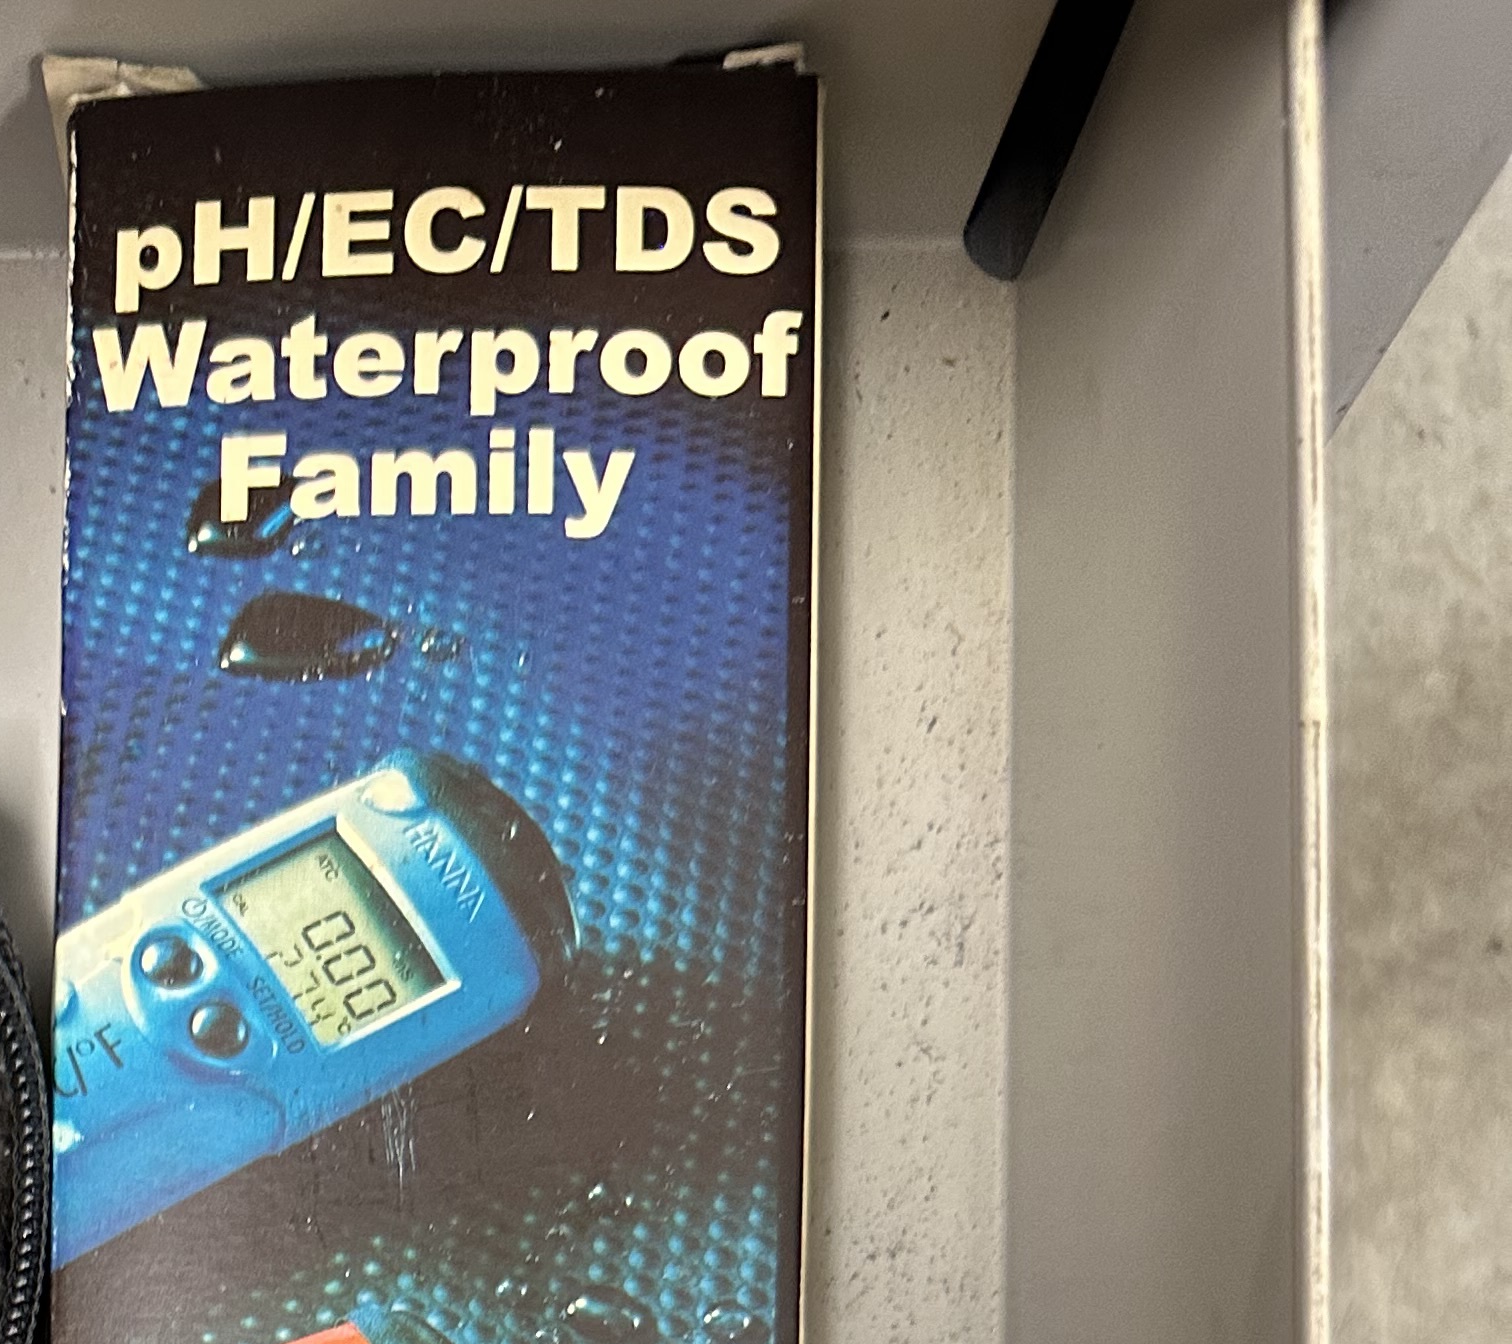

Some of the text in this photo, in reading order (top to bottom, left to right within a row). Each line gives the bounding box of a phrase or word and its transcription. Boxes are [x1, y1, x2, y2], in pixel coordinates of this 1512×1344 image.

[115, 184, 781, 313] pH/EC/TDS
[93, 310, 804, 416] Waterproof
[220, 427, 635, 540] Family
[317, 853, 339, 883] ATC
[404, 820, 485, 923] HANNA
[246, 974, 306, 1055] SET/HOLD
[301, 910, 397, 1021] 0.00
